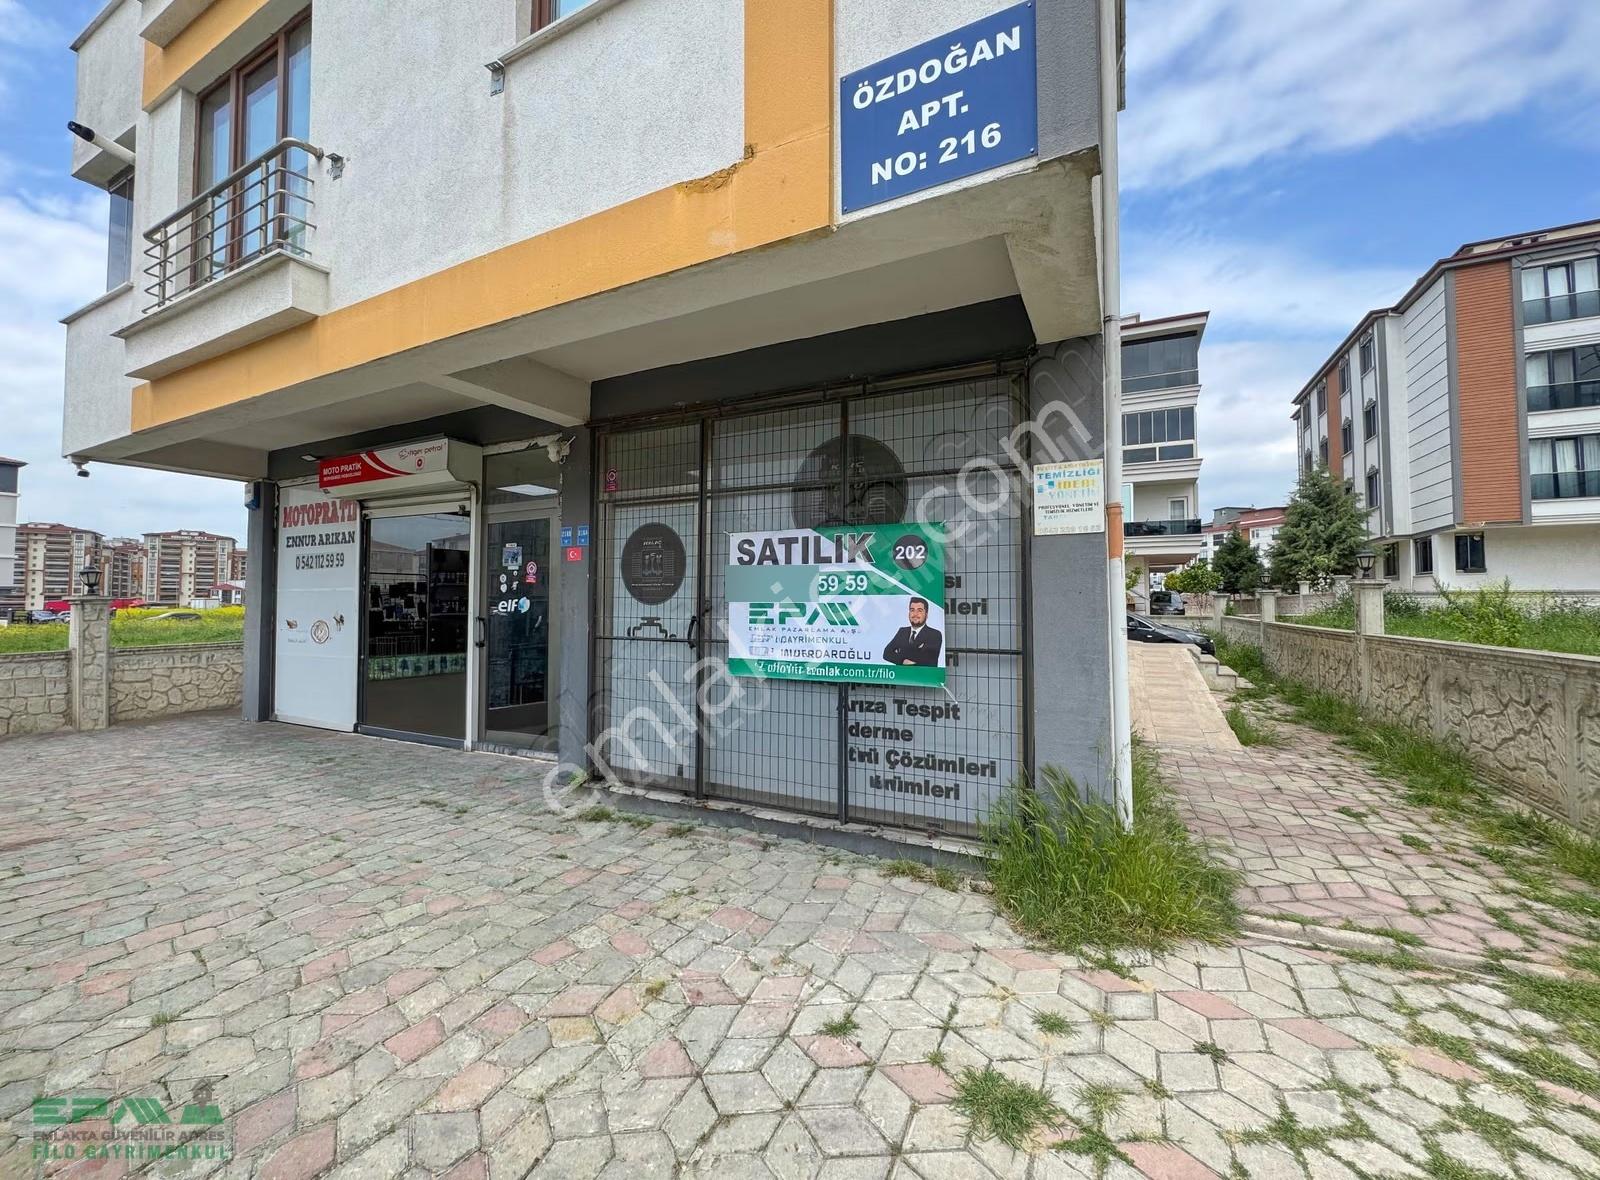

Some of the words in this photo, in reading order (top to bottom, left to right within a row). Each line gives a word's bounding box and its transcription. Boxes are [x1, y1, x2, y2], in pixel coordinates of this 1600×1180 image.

[853, 26, 1020, 109] ÖZDOĞAN
[897, 91, 968, 135] APT.
[871, 152, 926, 185] NO:
[939, 122, 1001, 163] 216
[323, 465, 339, 475] MOTO
[295, 556, 300, 570] 0
[301, 555, 313, 569] 542
[315, 554, 324, 569] 112
[325, 554, 334, 568] 59
[335, 553, 344, 567] 59
[737, 532, 875, 565] SATILIK
[895, 545, 925, 560] 202
[818, 575, 839, 591] 59
[845, 574, 868, 591] 59
[498, 599, 518, 612] elf
[893, 699, 961, 722] Tespit
[886, 748, 997, 778] Çözümleri
